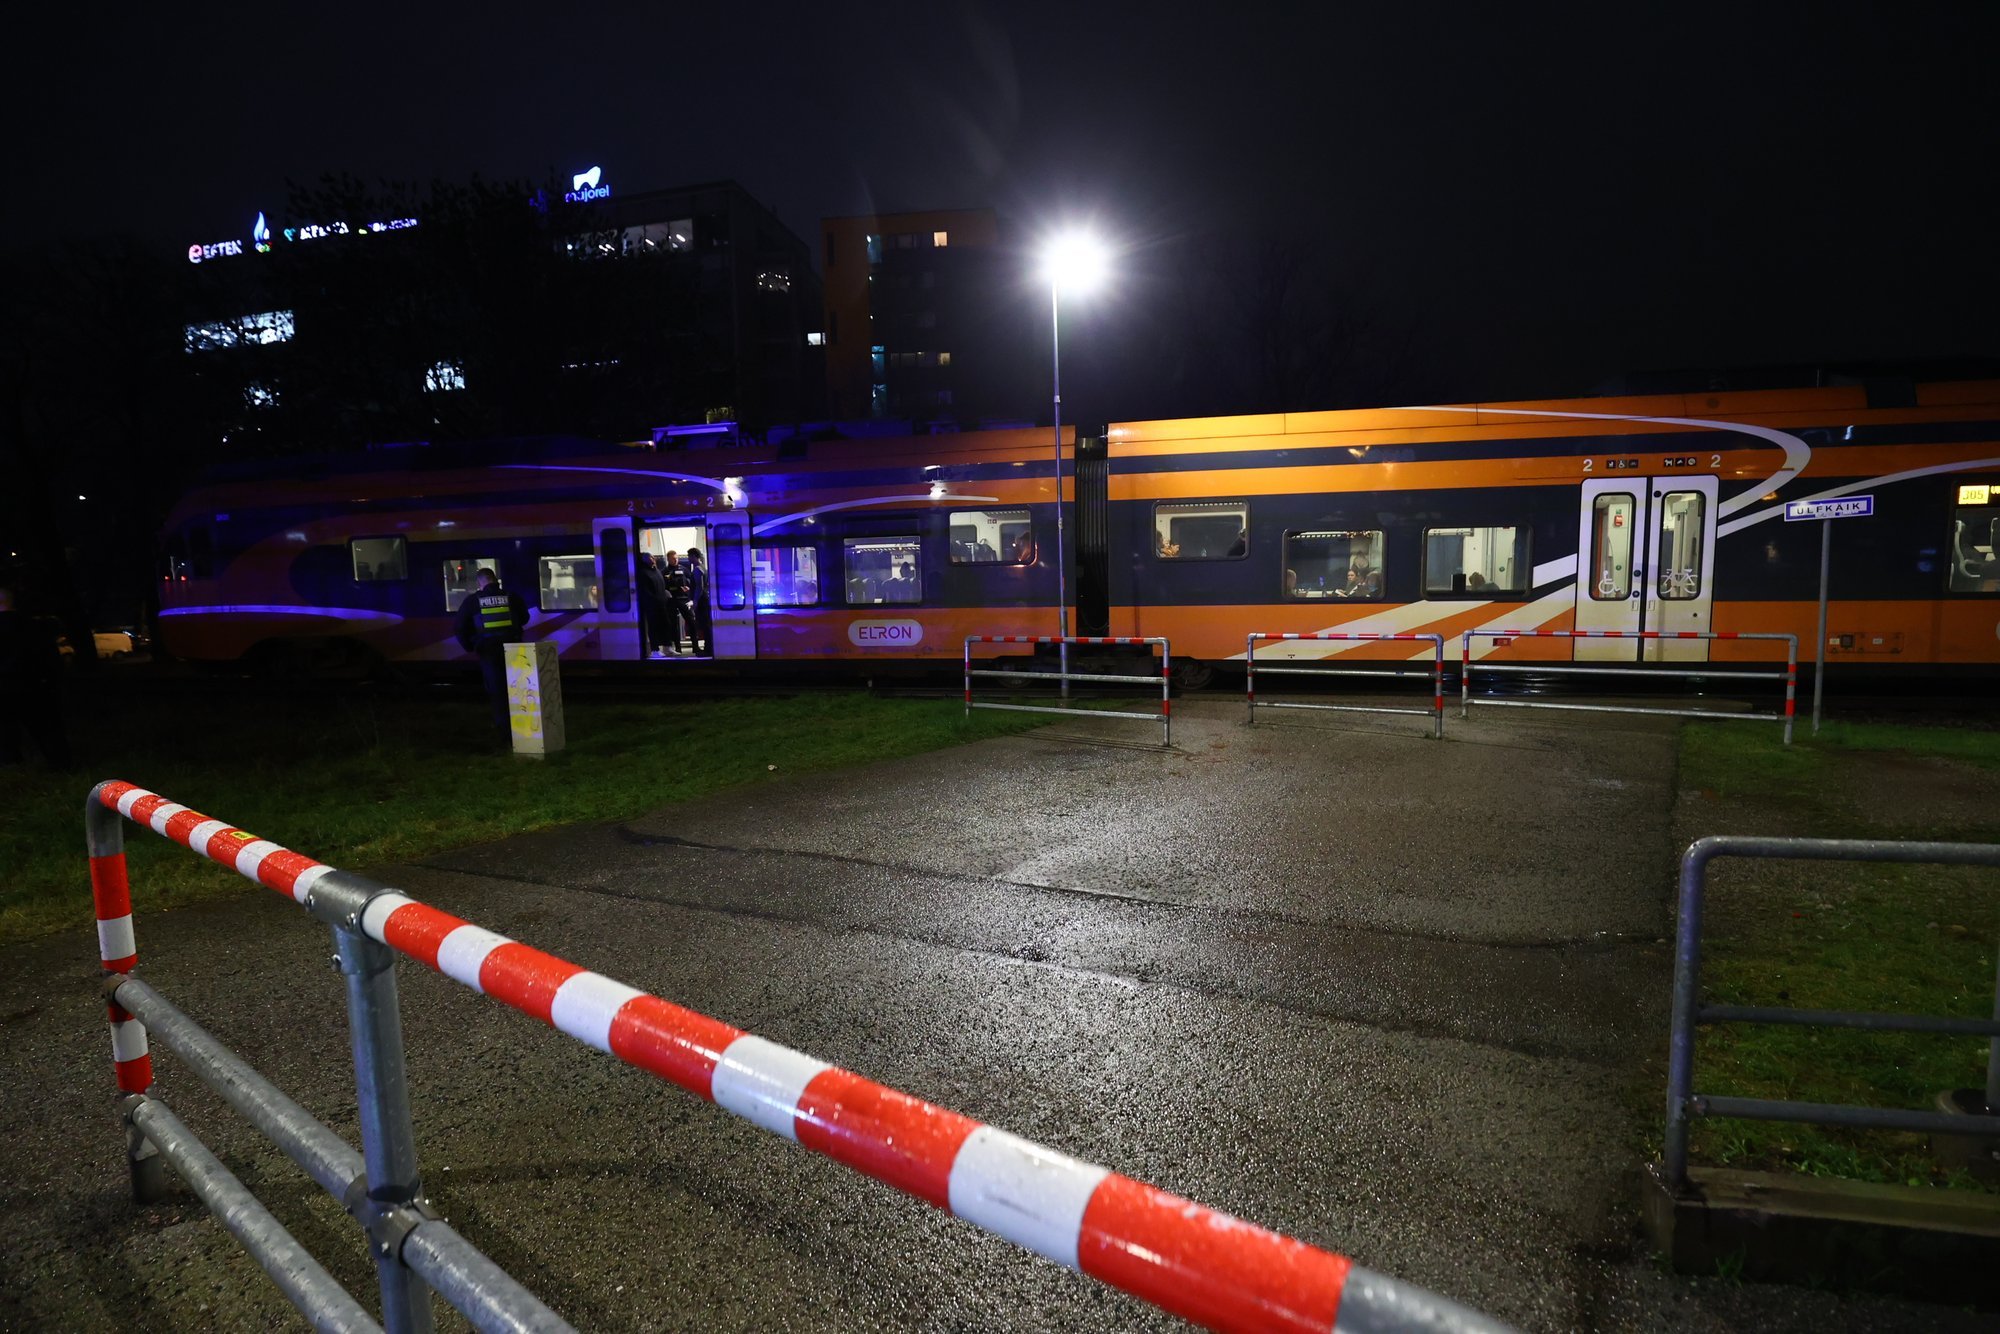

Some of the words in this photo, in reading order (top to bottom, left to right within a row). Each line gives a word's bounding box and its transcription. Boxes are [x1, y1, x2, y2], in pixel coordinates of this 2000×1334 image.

[1583, 459, 1593, 472] 2
[1711, 454, 1721, 468] 2
[627, 500, 634, 511] 2
[706, 496, 714, 507] 2
[858, 626, 912, 640] ELRON
